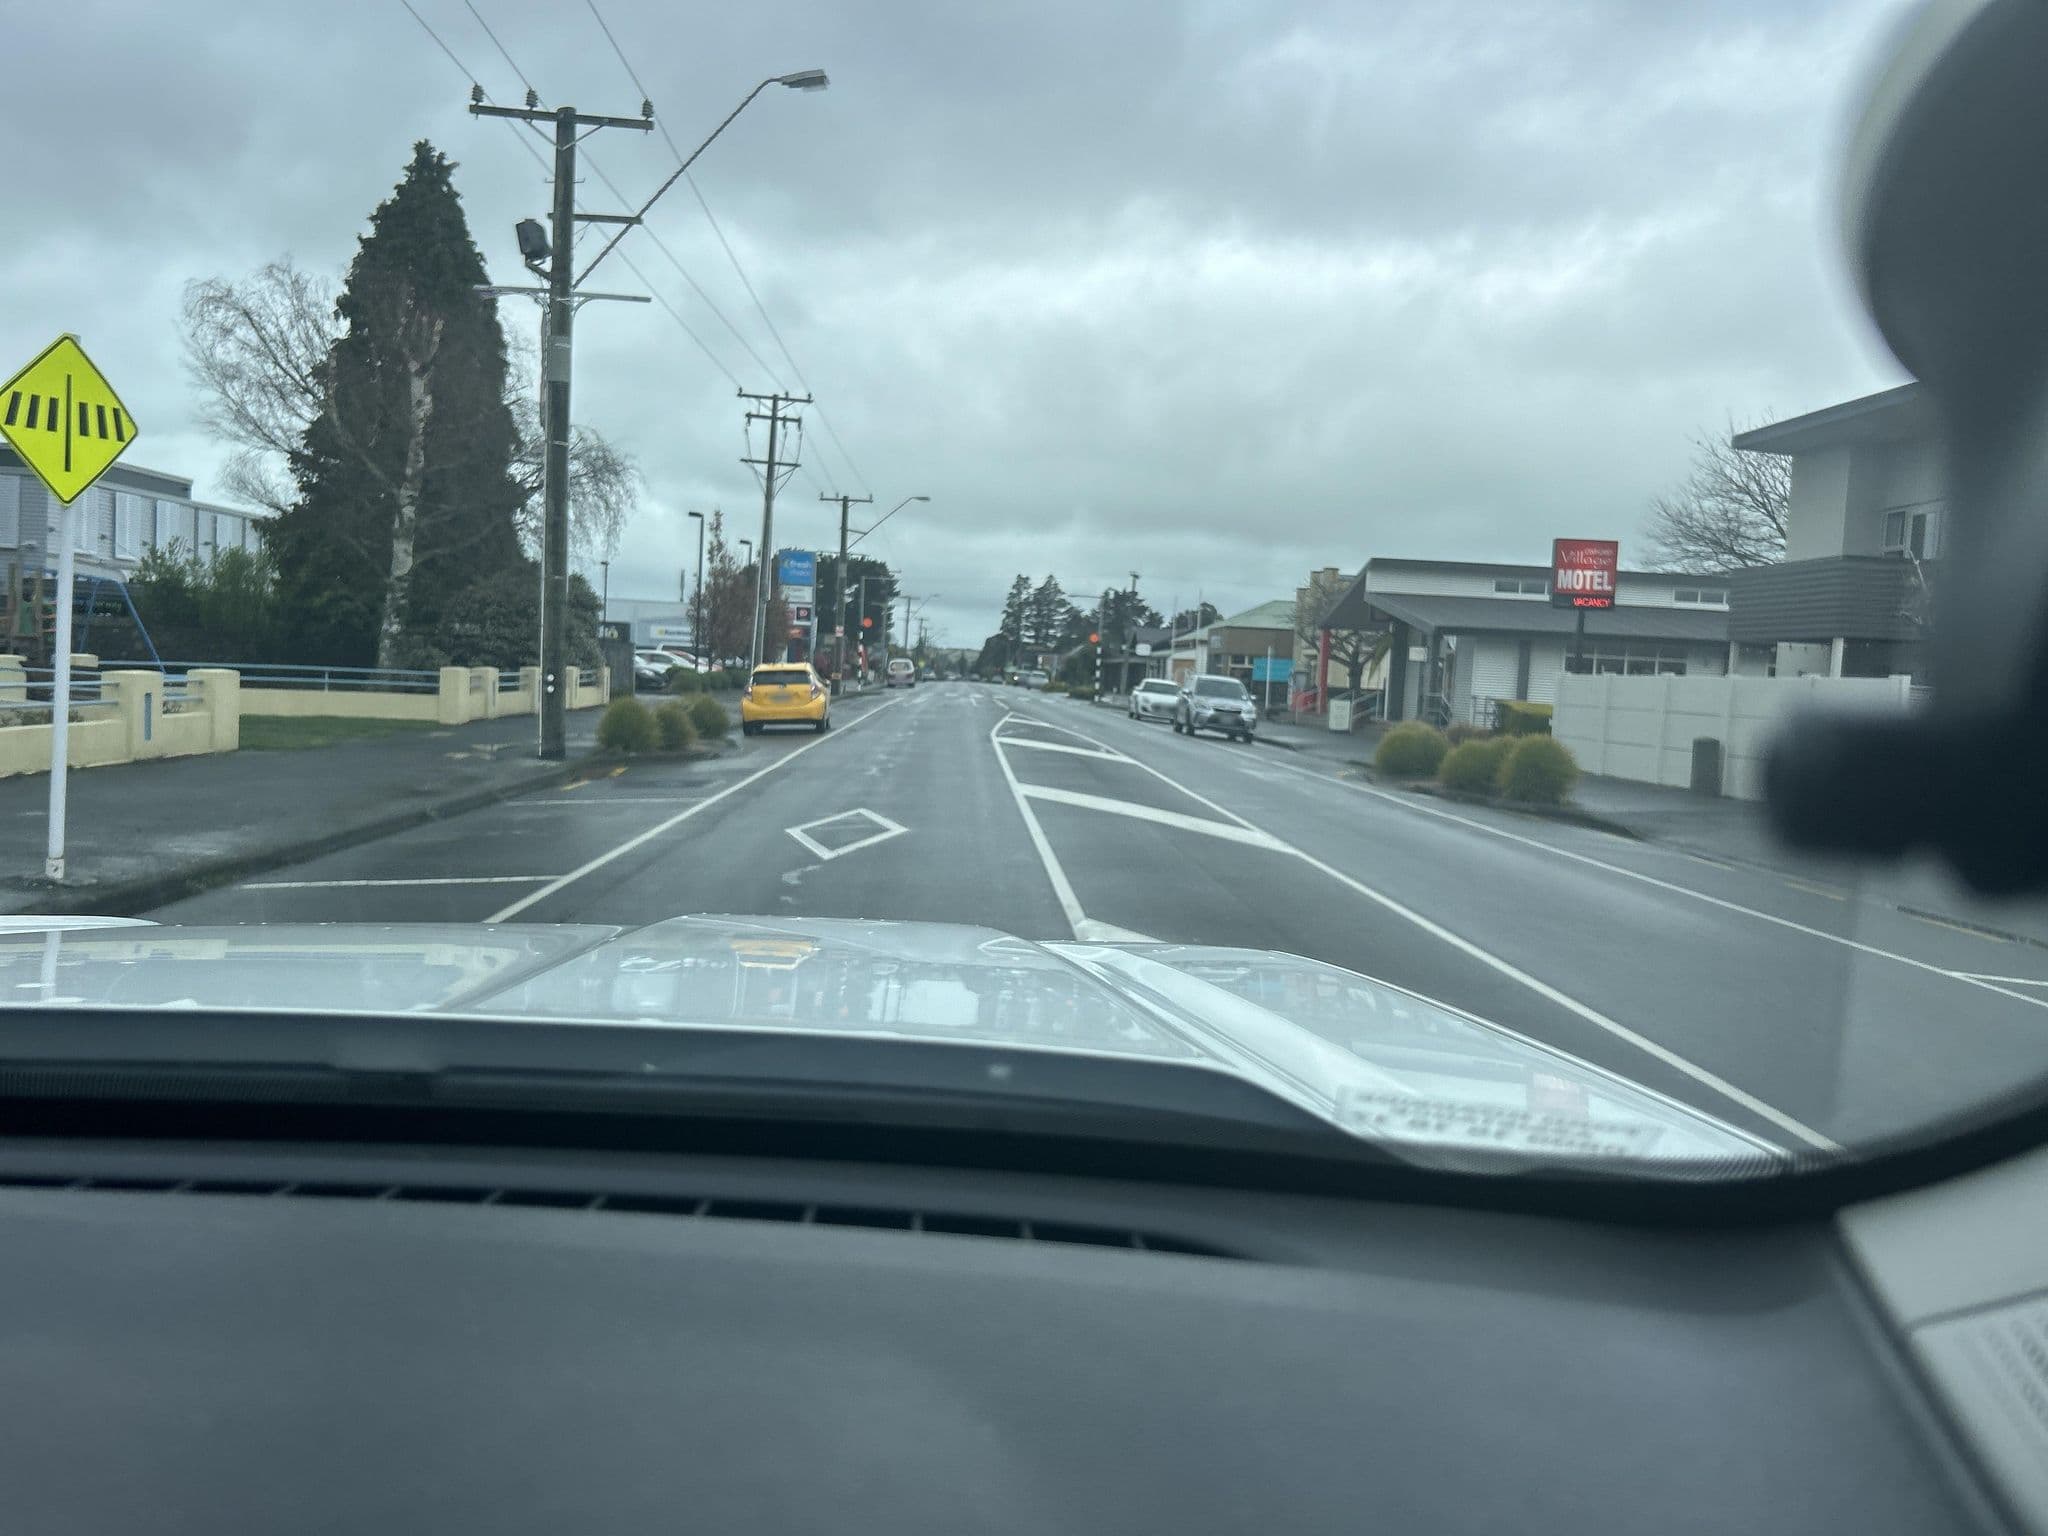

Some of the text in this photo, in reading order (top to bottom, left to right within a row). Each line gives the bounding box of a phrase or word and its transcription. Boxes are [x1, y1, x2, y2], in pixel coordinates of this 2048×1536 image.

[1561, 550, 1611, 569] Village
[1557, 569, 1612, 590] MOTEL
[1573, 598, 1610, 607] VACANCY
